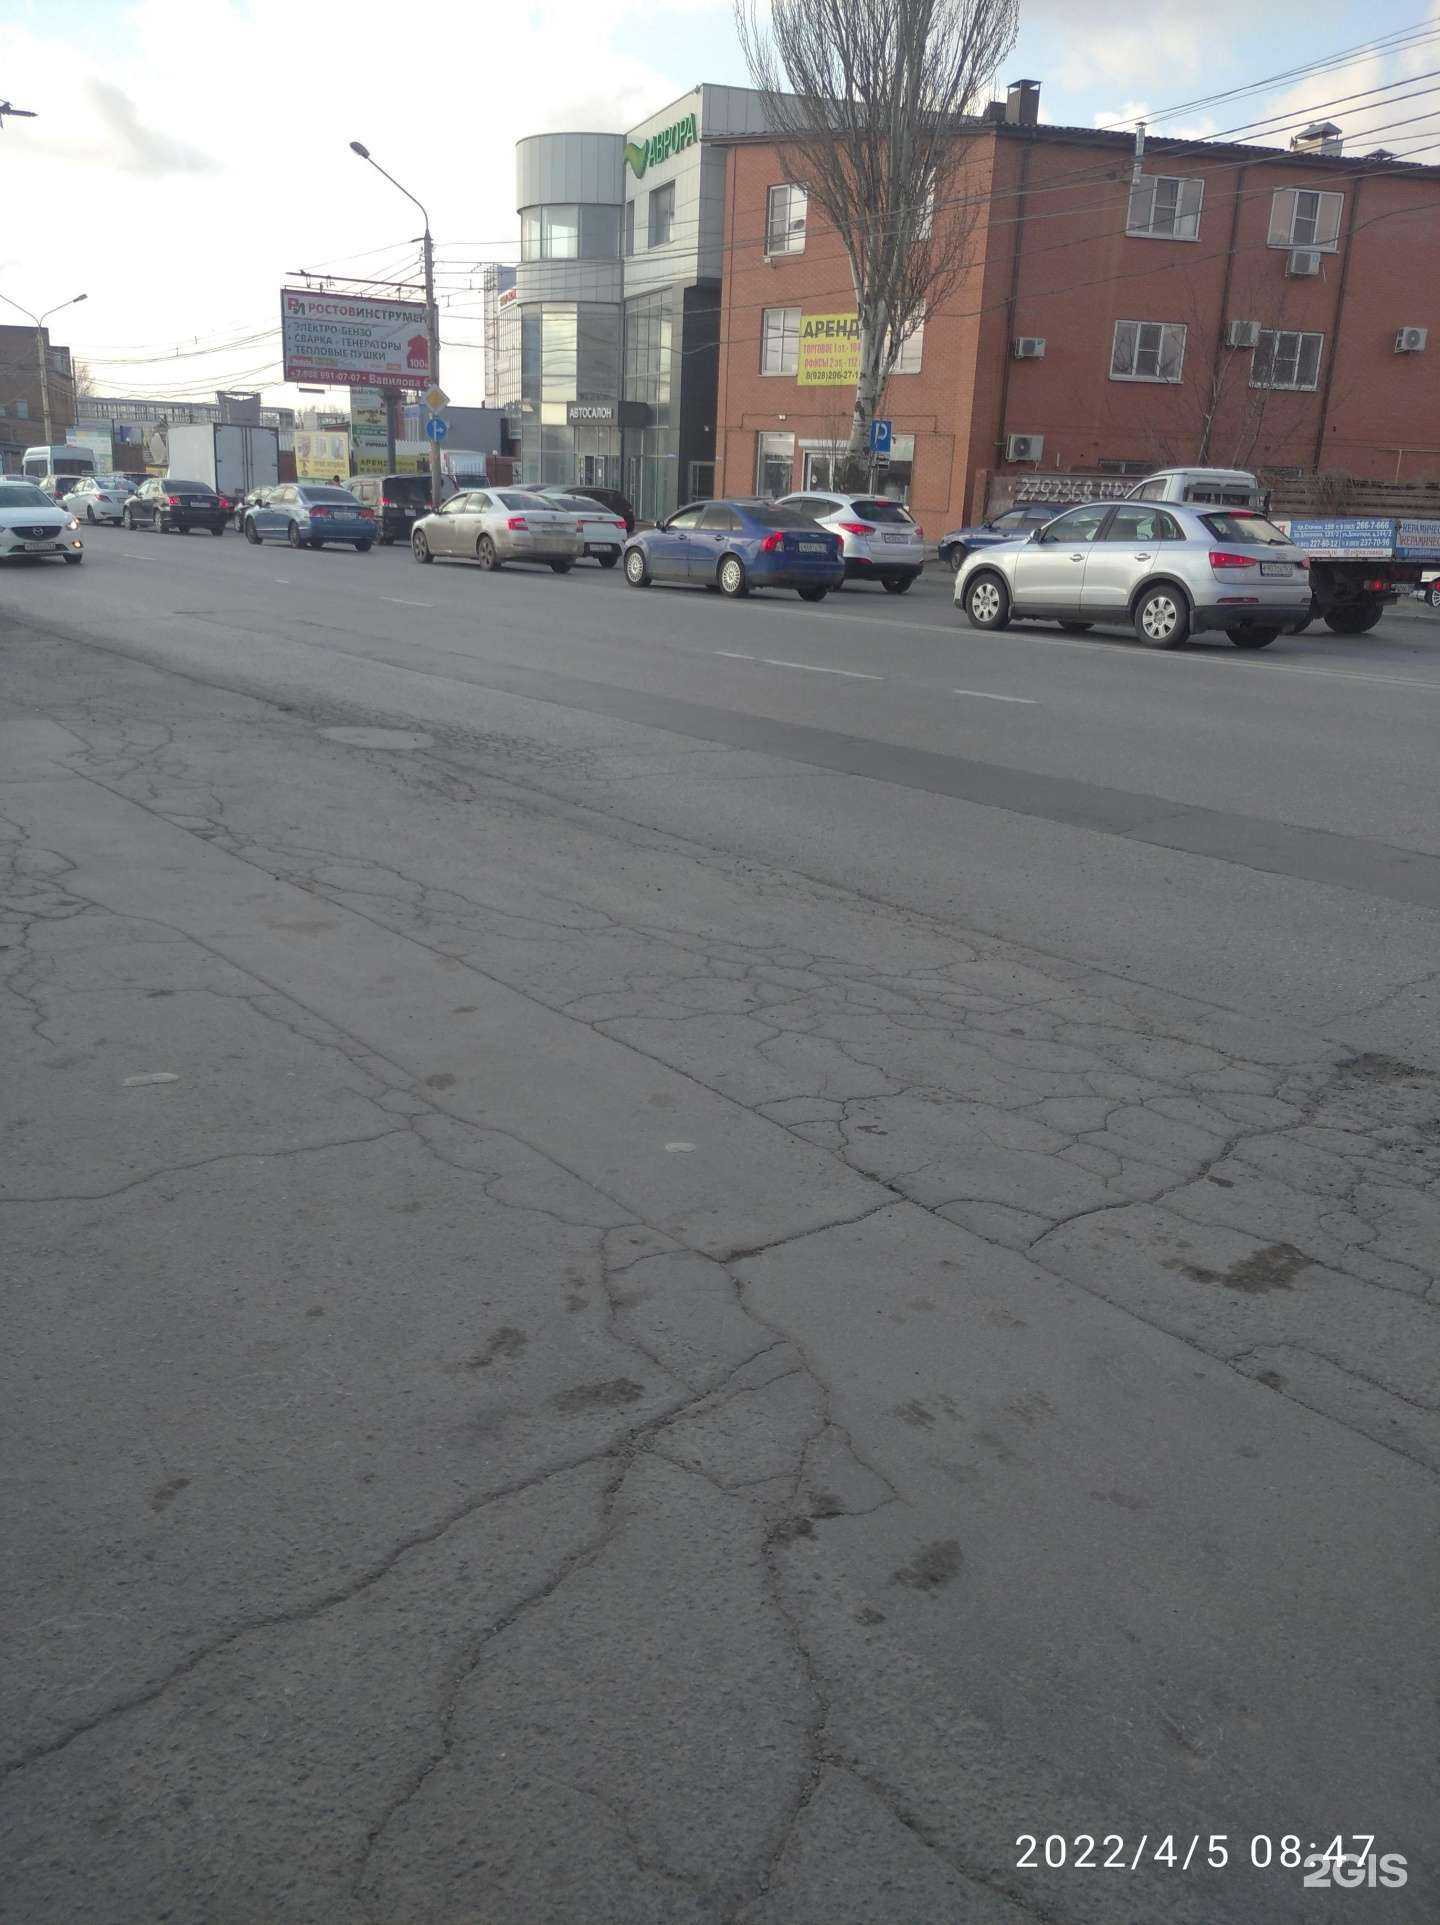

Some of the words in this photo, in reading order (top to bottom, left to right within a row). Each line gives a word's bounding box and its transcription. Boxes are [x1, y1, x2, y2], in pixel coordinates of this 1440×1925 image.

[645, 112, 698, 168] АВРОРА
[803, 319, 860, 340] АРЕНД
[294, 334, 333, 344] СВАРКА
[341, 339, 402, 351] ГЕНЕРАТОРЫ
[295, 345, 348, 359] ТЕПЛОВЫЕ
[350, 350, 386, 361] ПУШКИ
[569, 407, 612, 419] АВТОСАЛОН
